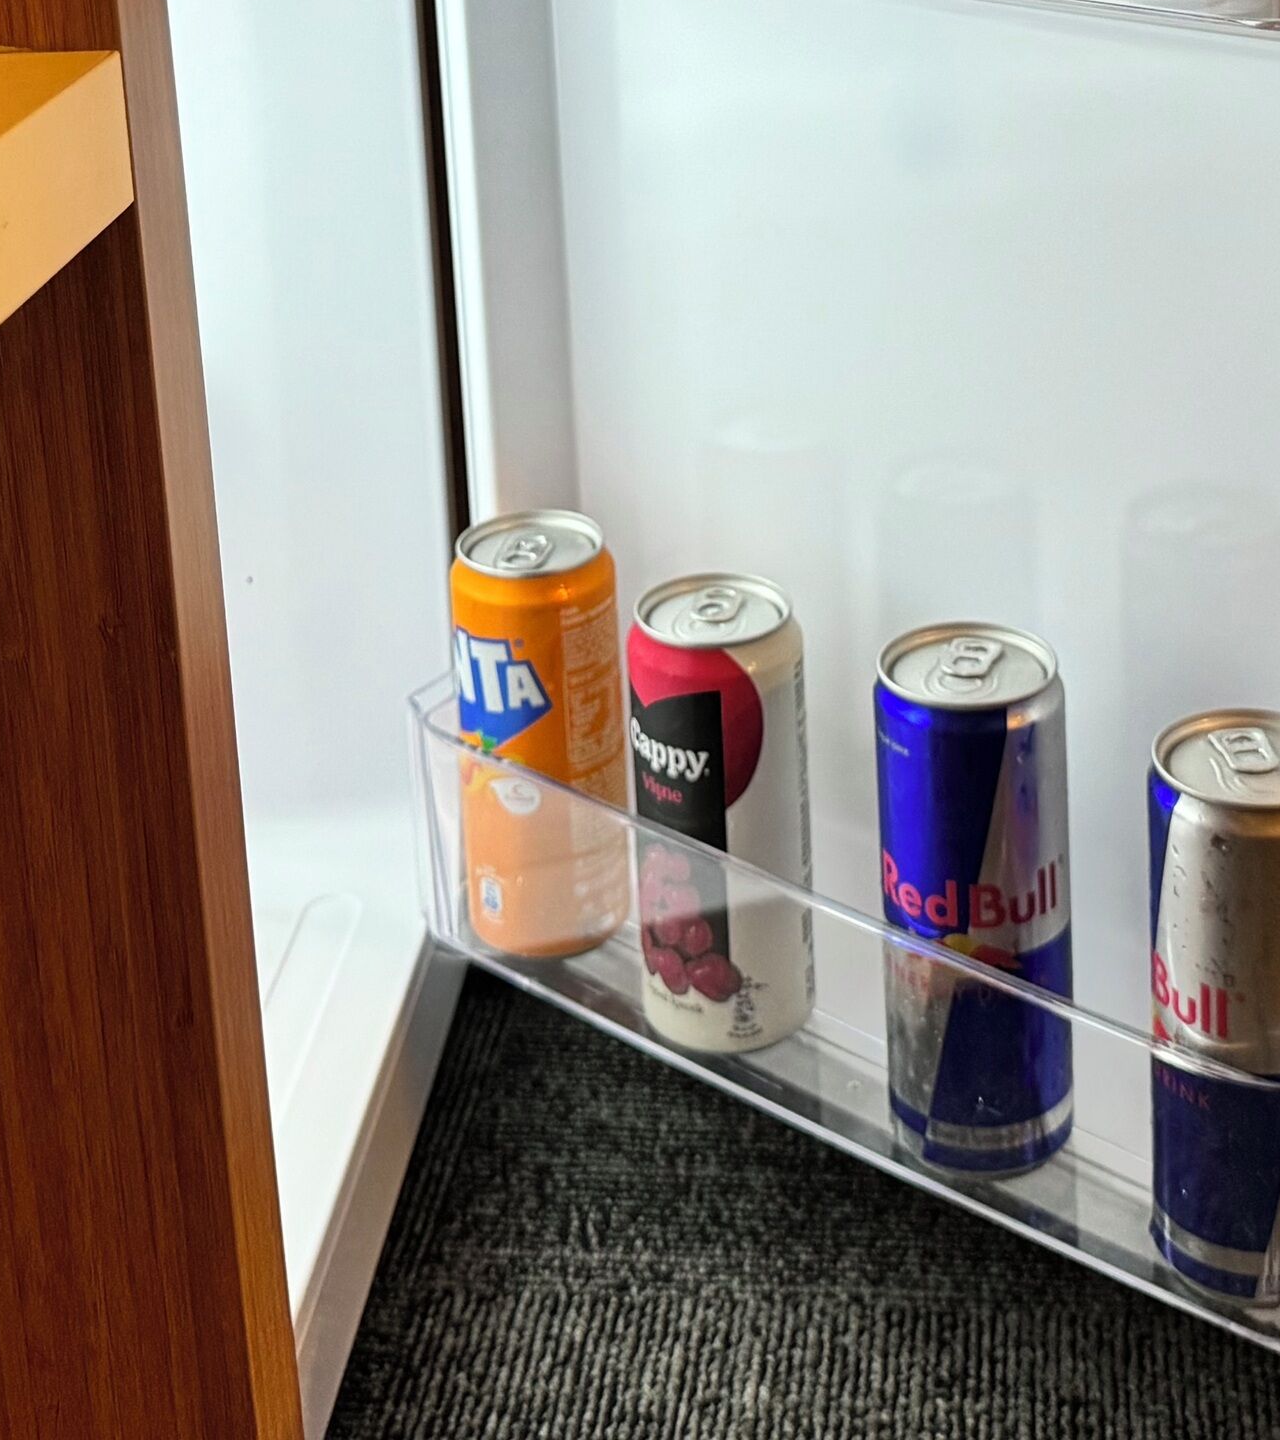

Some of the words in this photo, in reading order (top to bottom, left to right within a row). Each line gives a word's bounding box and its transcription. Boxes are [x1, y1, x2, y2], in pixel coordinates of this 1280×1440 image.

[630, 716, 709, 783] Cappy
[883, 849, 958, 927] Red
[969, 860, 1057, 929] Bull
[1151, 950, 1229, 1040] Bull
